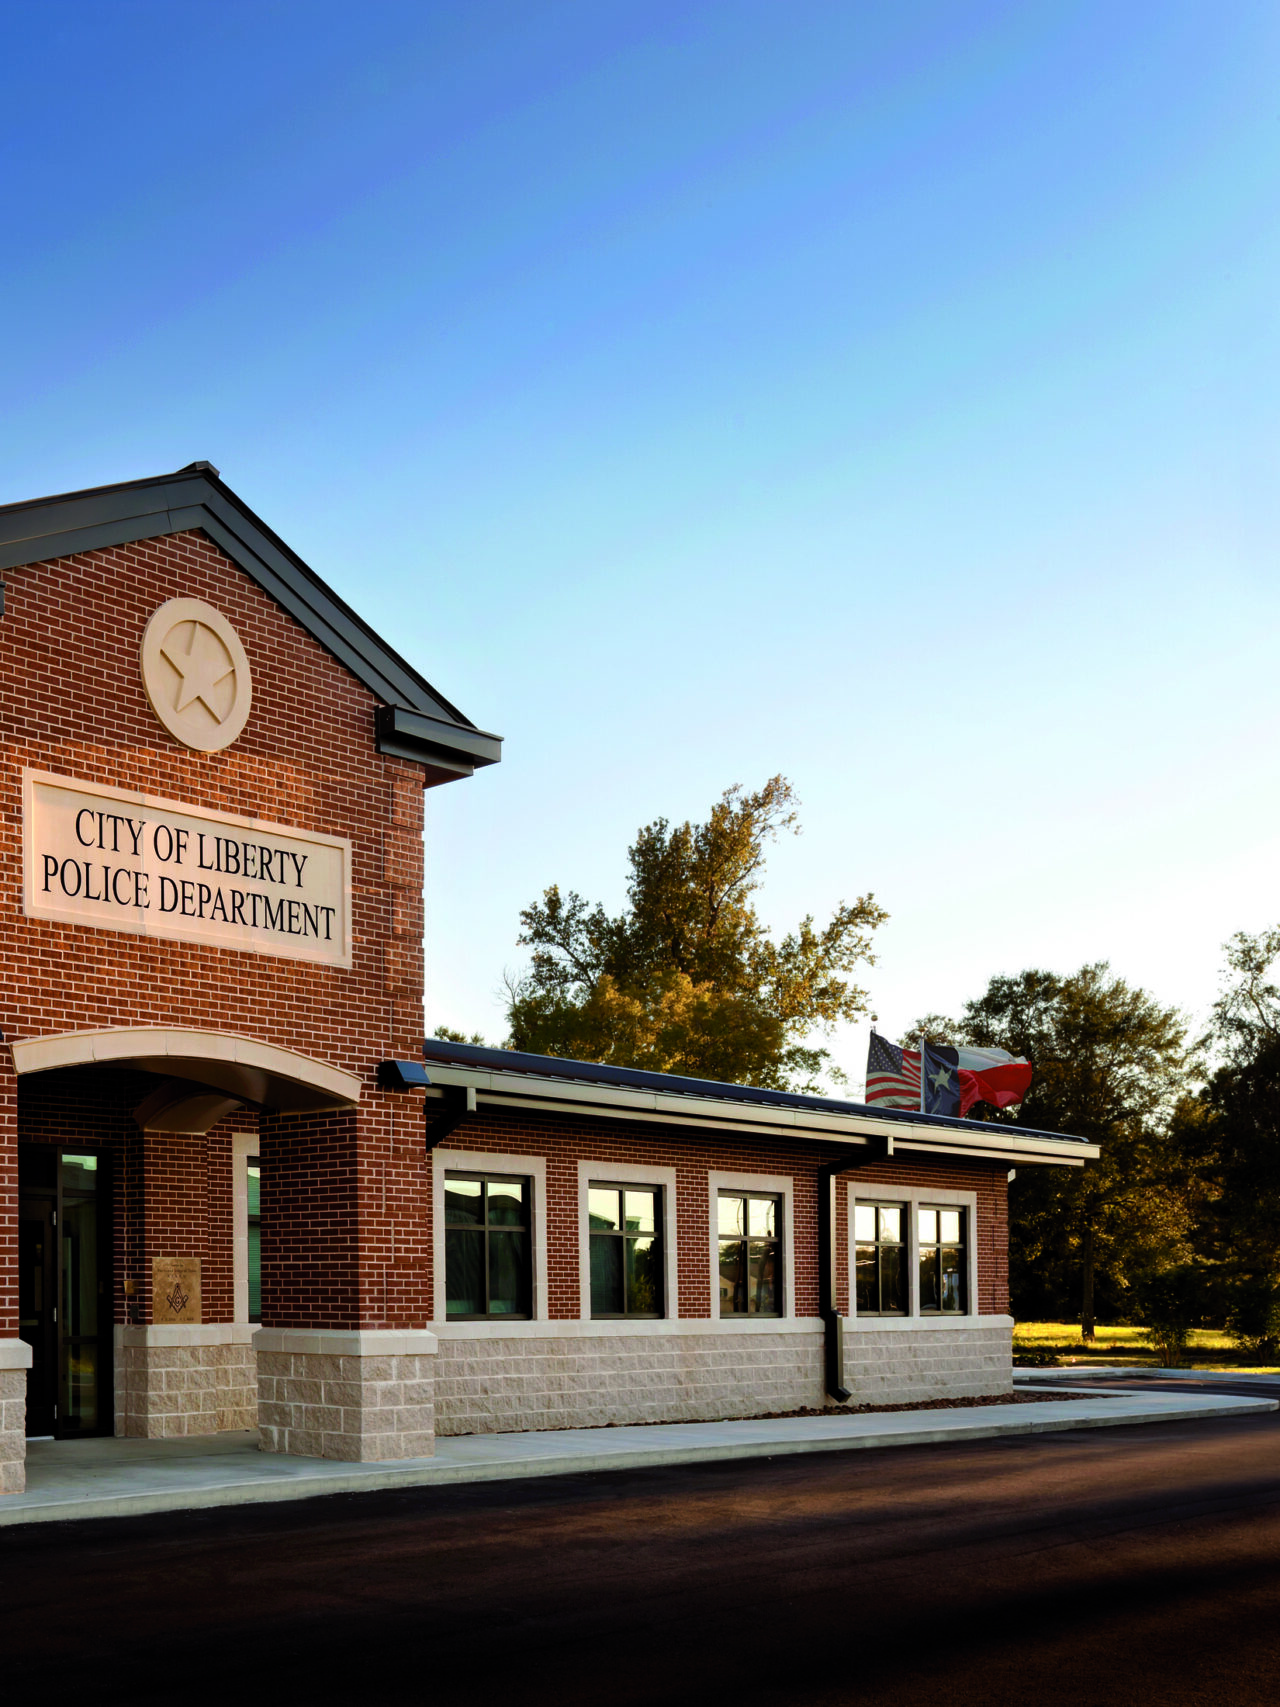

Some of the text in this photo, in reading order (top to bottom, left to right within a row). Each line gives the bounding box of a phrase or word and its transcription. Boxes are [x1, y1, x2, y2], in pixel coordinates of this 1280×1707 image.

[75, 808, 308, 887] CITY OF LIBERTY
[41, 854, 336, 940] POLICE DEPARTMENT
